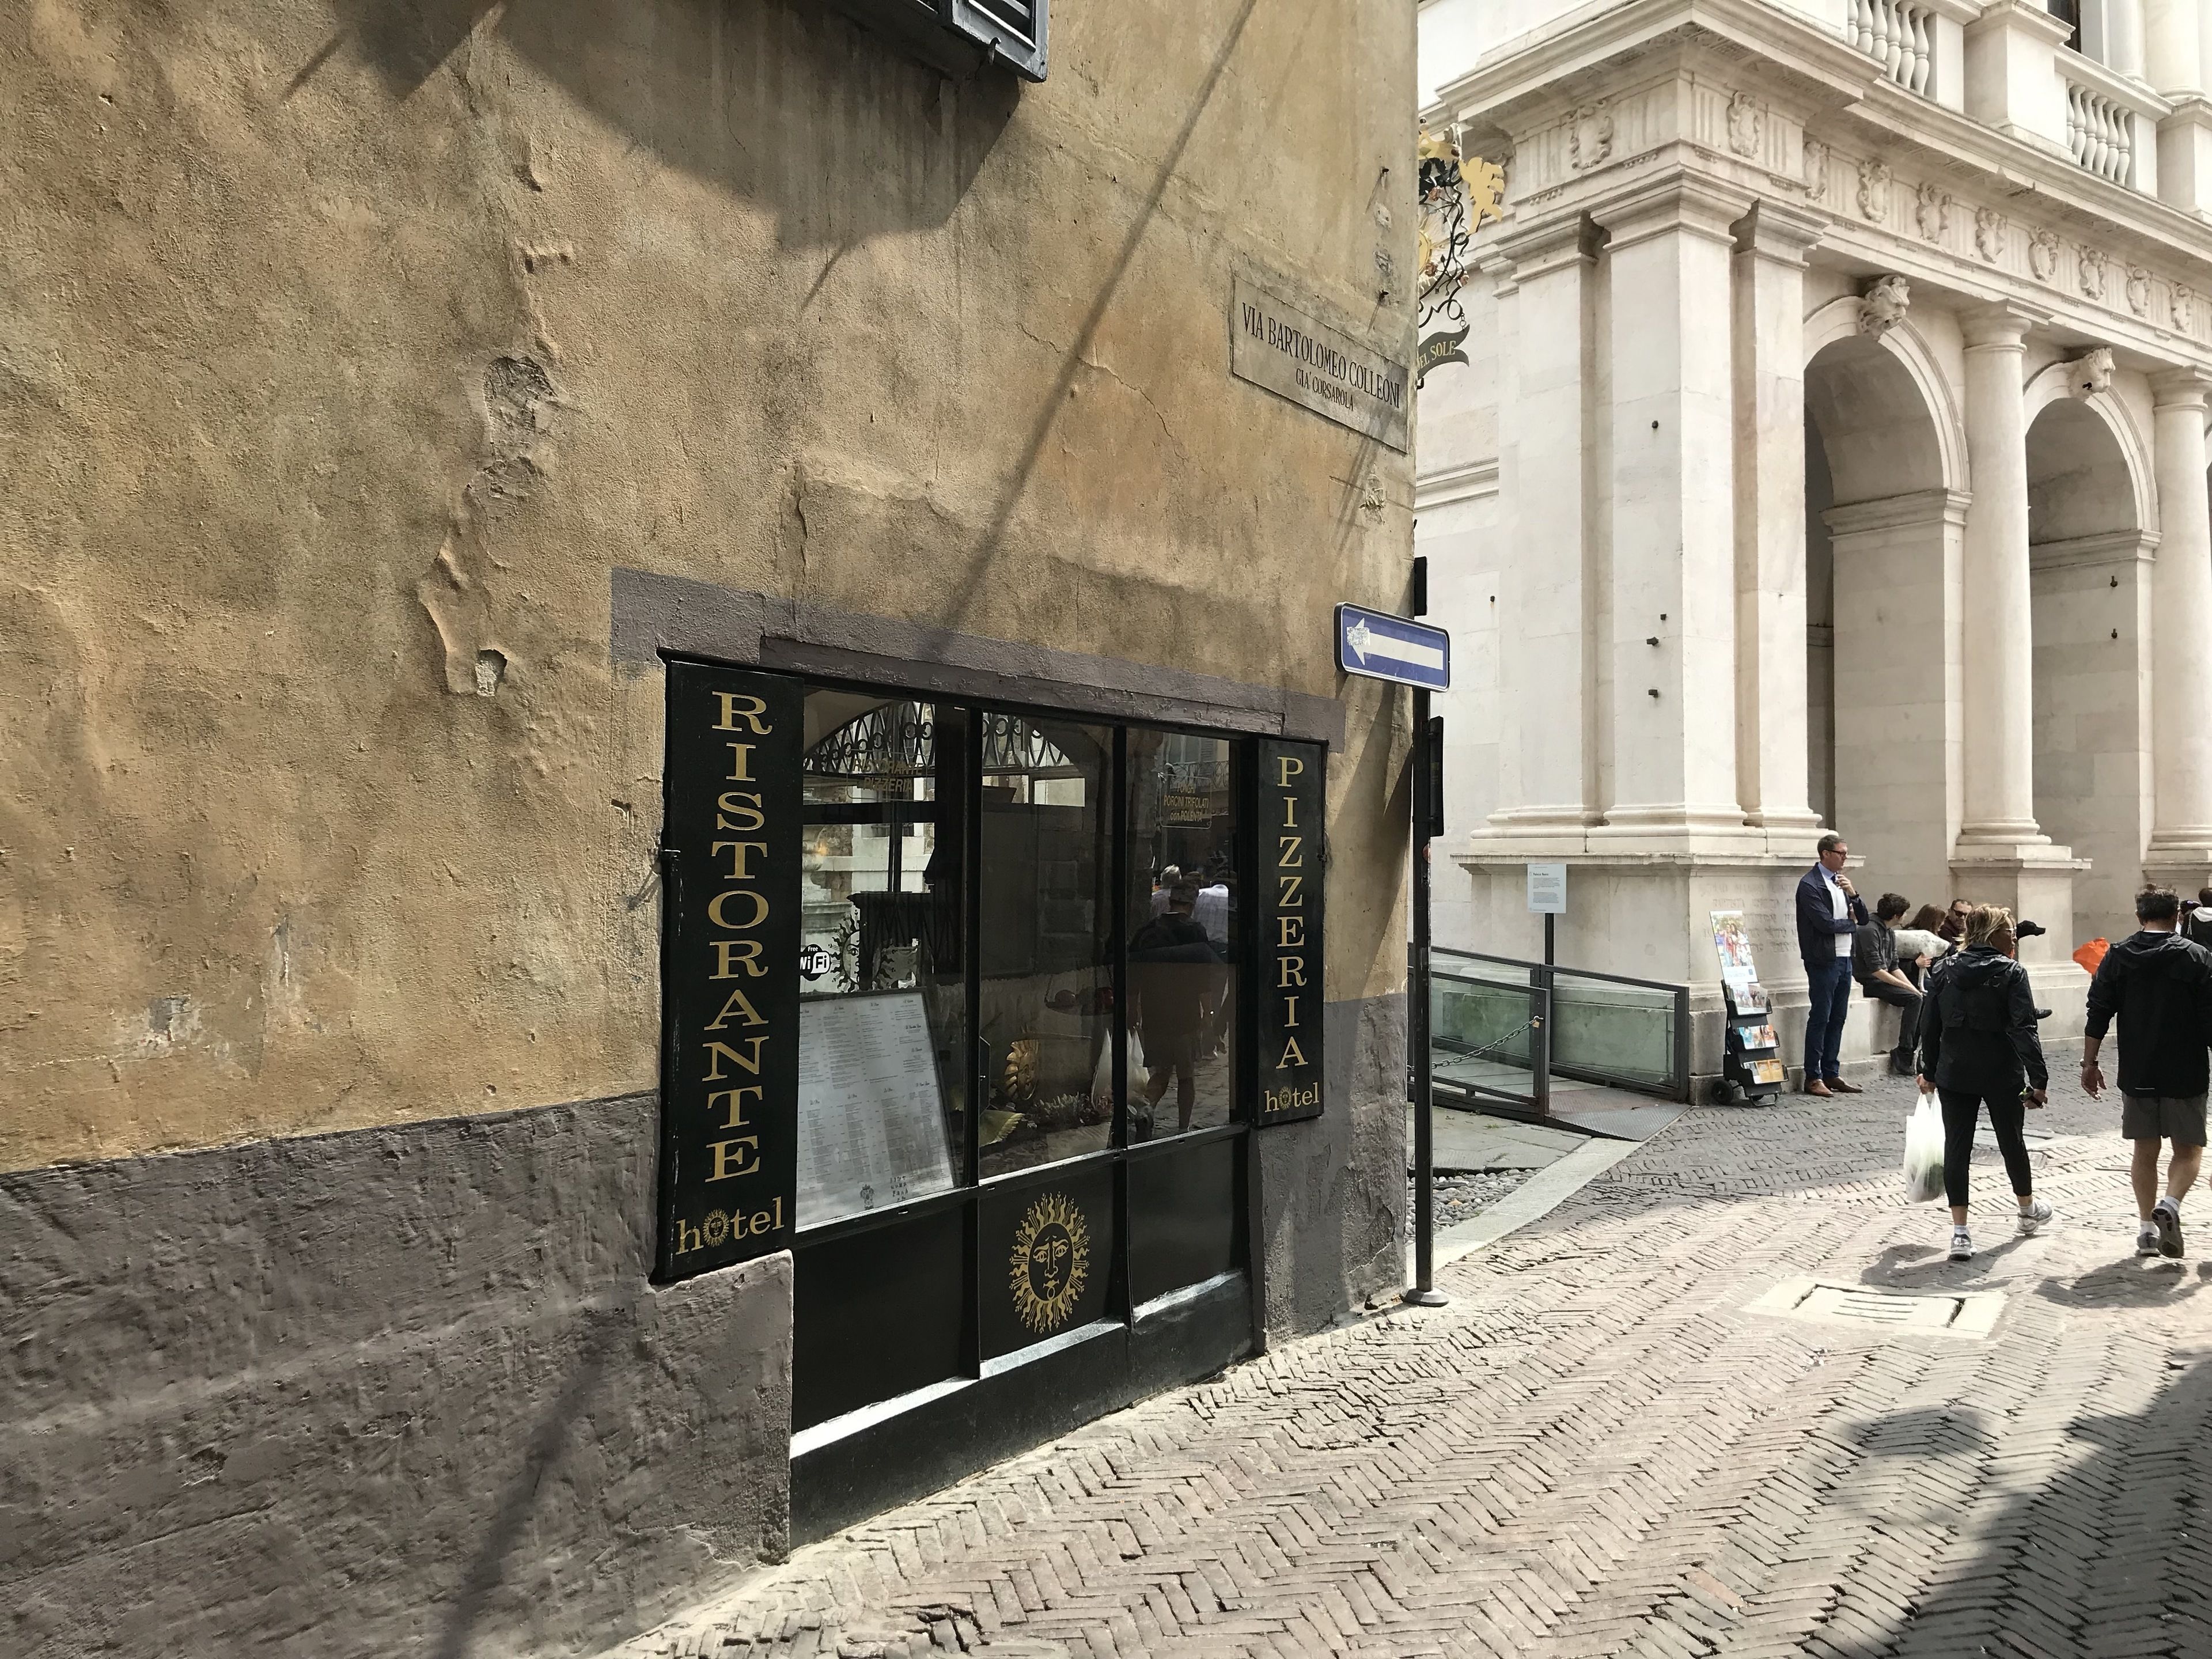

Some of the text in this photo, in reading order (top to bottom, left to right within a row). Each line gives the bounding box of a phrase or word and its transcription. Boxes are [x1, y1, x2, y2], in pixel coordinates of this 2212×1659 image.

[1242, 302, 1401, 409] VIA BARTOLOMEO COLLEONI
[1430, 340, 1456, 361] SOLE
[1312, 376, 1354, 412] CORSAROLA
[863, 777, 912, 793] PIZZERIA
[702, 690, 772, 1183] RISTORANTE
[1275, 756, 1308, 1070] PIZZERIA
